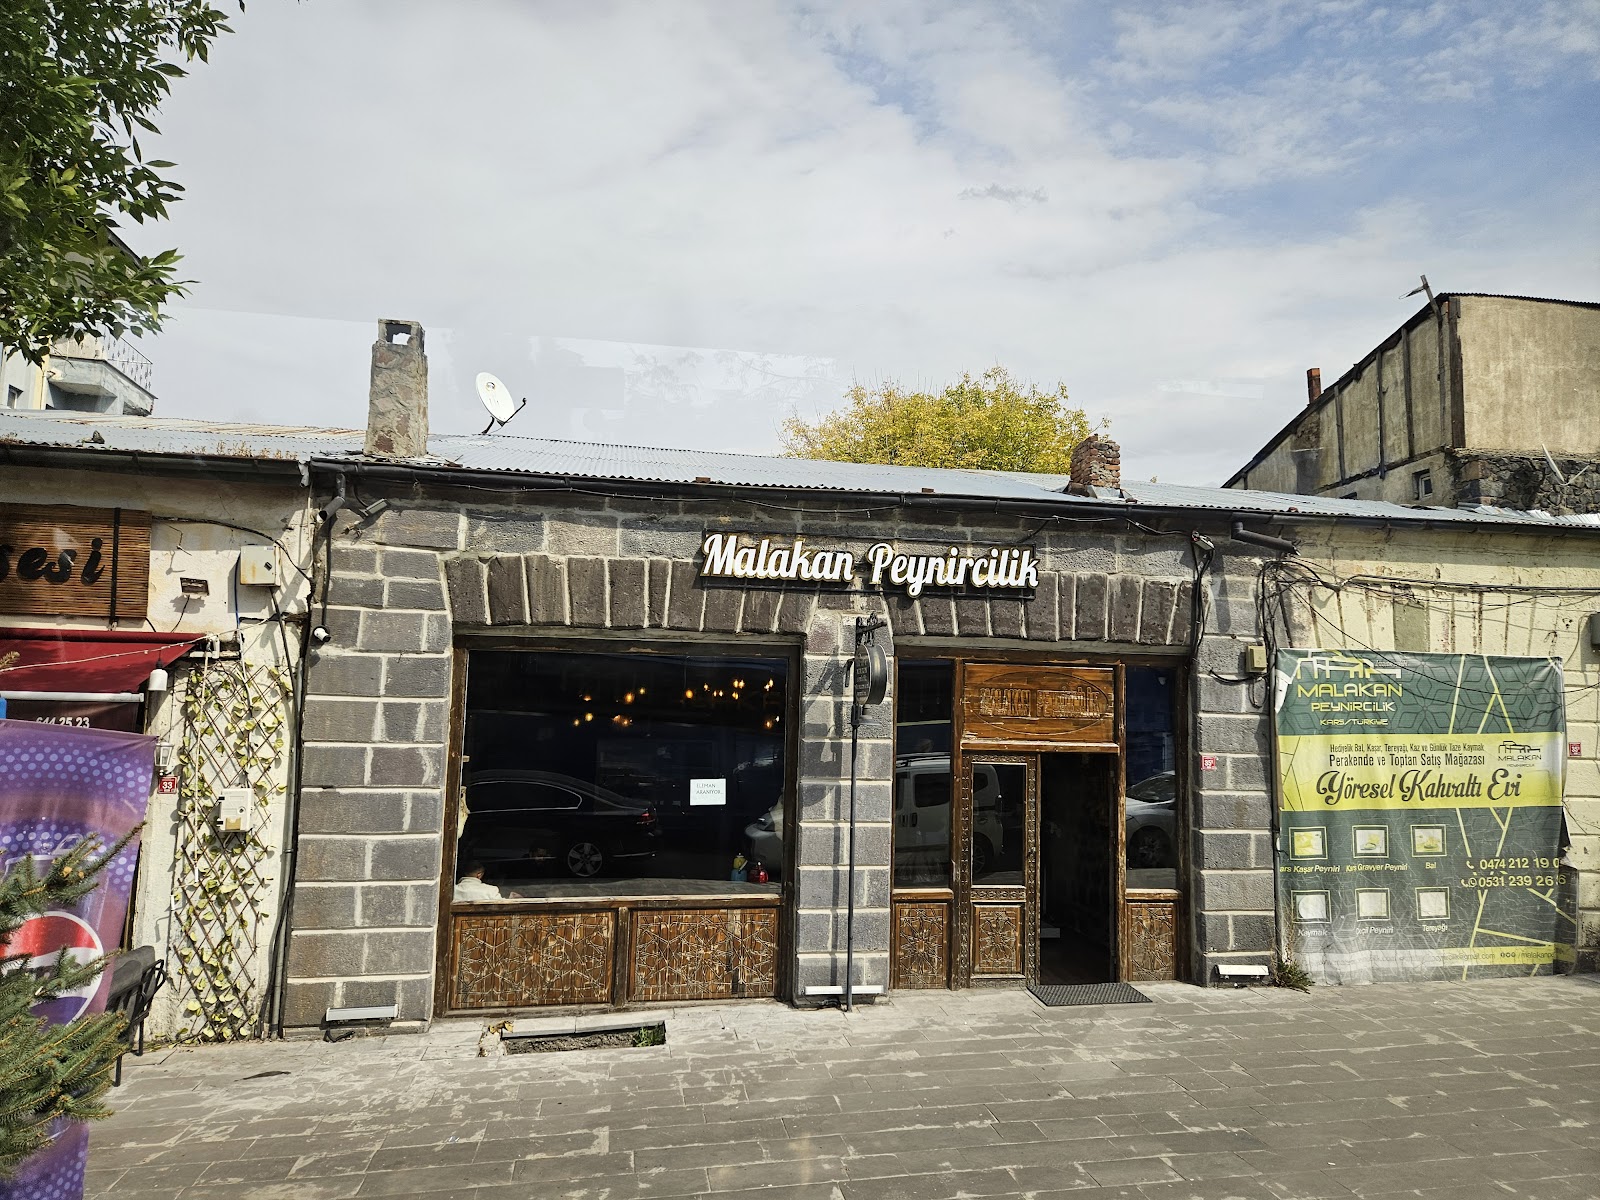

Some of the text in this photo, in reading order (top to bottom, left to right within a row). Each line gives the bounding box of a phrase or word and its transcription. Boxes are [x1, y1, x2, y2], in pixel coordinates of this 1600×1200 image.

[702, 533, 1039, 597] Malakan Peynircilik
[1297, 683, 1402, 698] MALAKAN
[1421, 744, 1428, 752] ve
[1462, 743, 1485, 753] Kaymak
[1329, 753, 1485, 768] Perakende ve Toptan Satış Mağazası
[162, 781, 173, 789] 33
[1316, 768, 1522, 806] Yöresel Kahvaltı Evi
[1479, 859, 1506, 870] 0474
[1508, 858, 1529, 869] 212
[1533, 858, 1550, 869] 19
[1478, 876, 1505, 888] 0531
[1508, 875, 1532, 887] 239
[1535, 875, 1554, 886] 26
